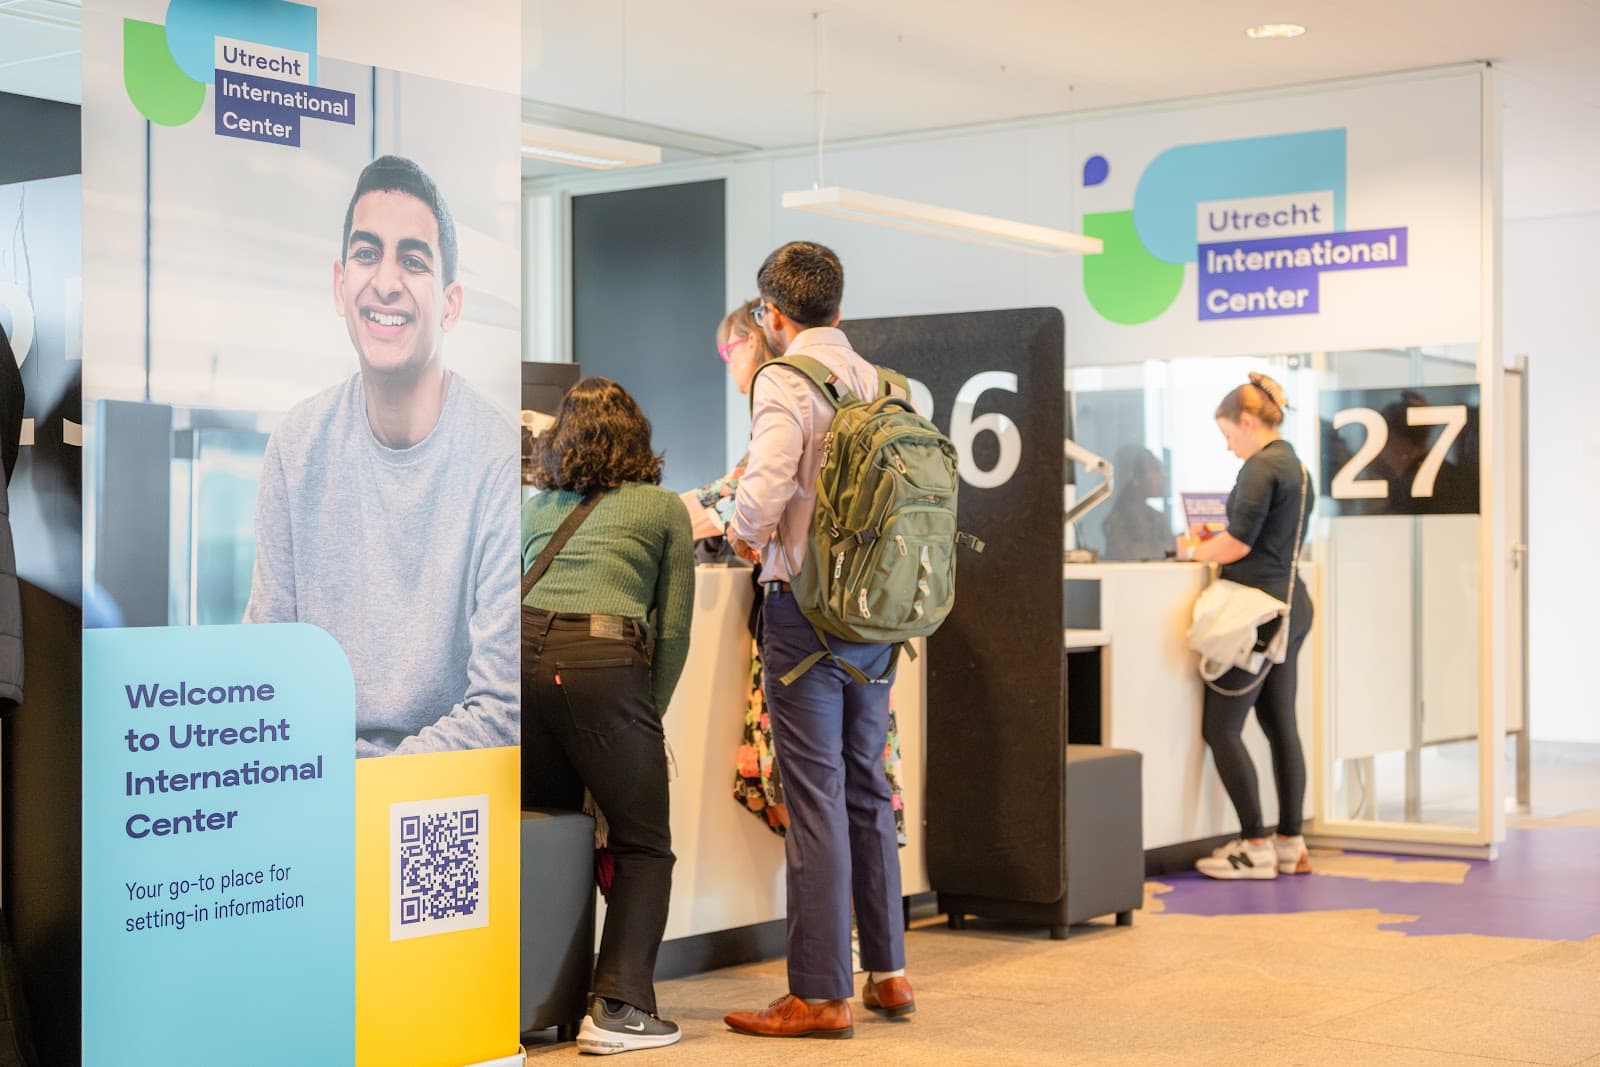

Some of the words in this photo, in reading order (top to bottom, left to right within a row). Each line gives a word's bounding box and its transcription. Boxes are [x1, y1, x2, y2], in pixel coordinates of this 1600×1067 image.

[223, 45, 302, 76] Utrecht
[223, 78, 349, 117] International
[222, 111, 293, 139] Center
[1208, 202, 1321, 232] Utrecht
[1206, 234, 1398, 274] International
[1206, 286, 1310, 314] Center
[1331, 405, 1467, 499] 27
[124, 681, 275, 709] Welcome
[124, 728, 160, 753] to
[169, 718, 290, 749] Utrecht
[125, 754, 323, 796] International
[125, 808, 238, 839] Center
[125, 881, 164, 901] Your
[169, 874, 215, 900] go-to
[221, 868, 264, 894] place
[269, 863, 292, 882] for
[125, 904, 208, 932] setting-in
[214, 892, 304, 920] information
